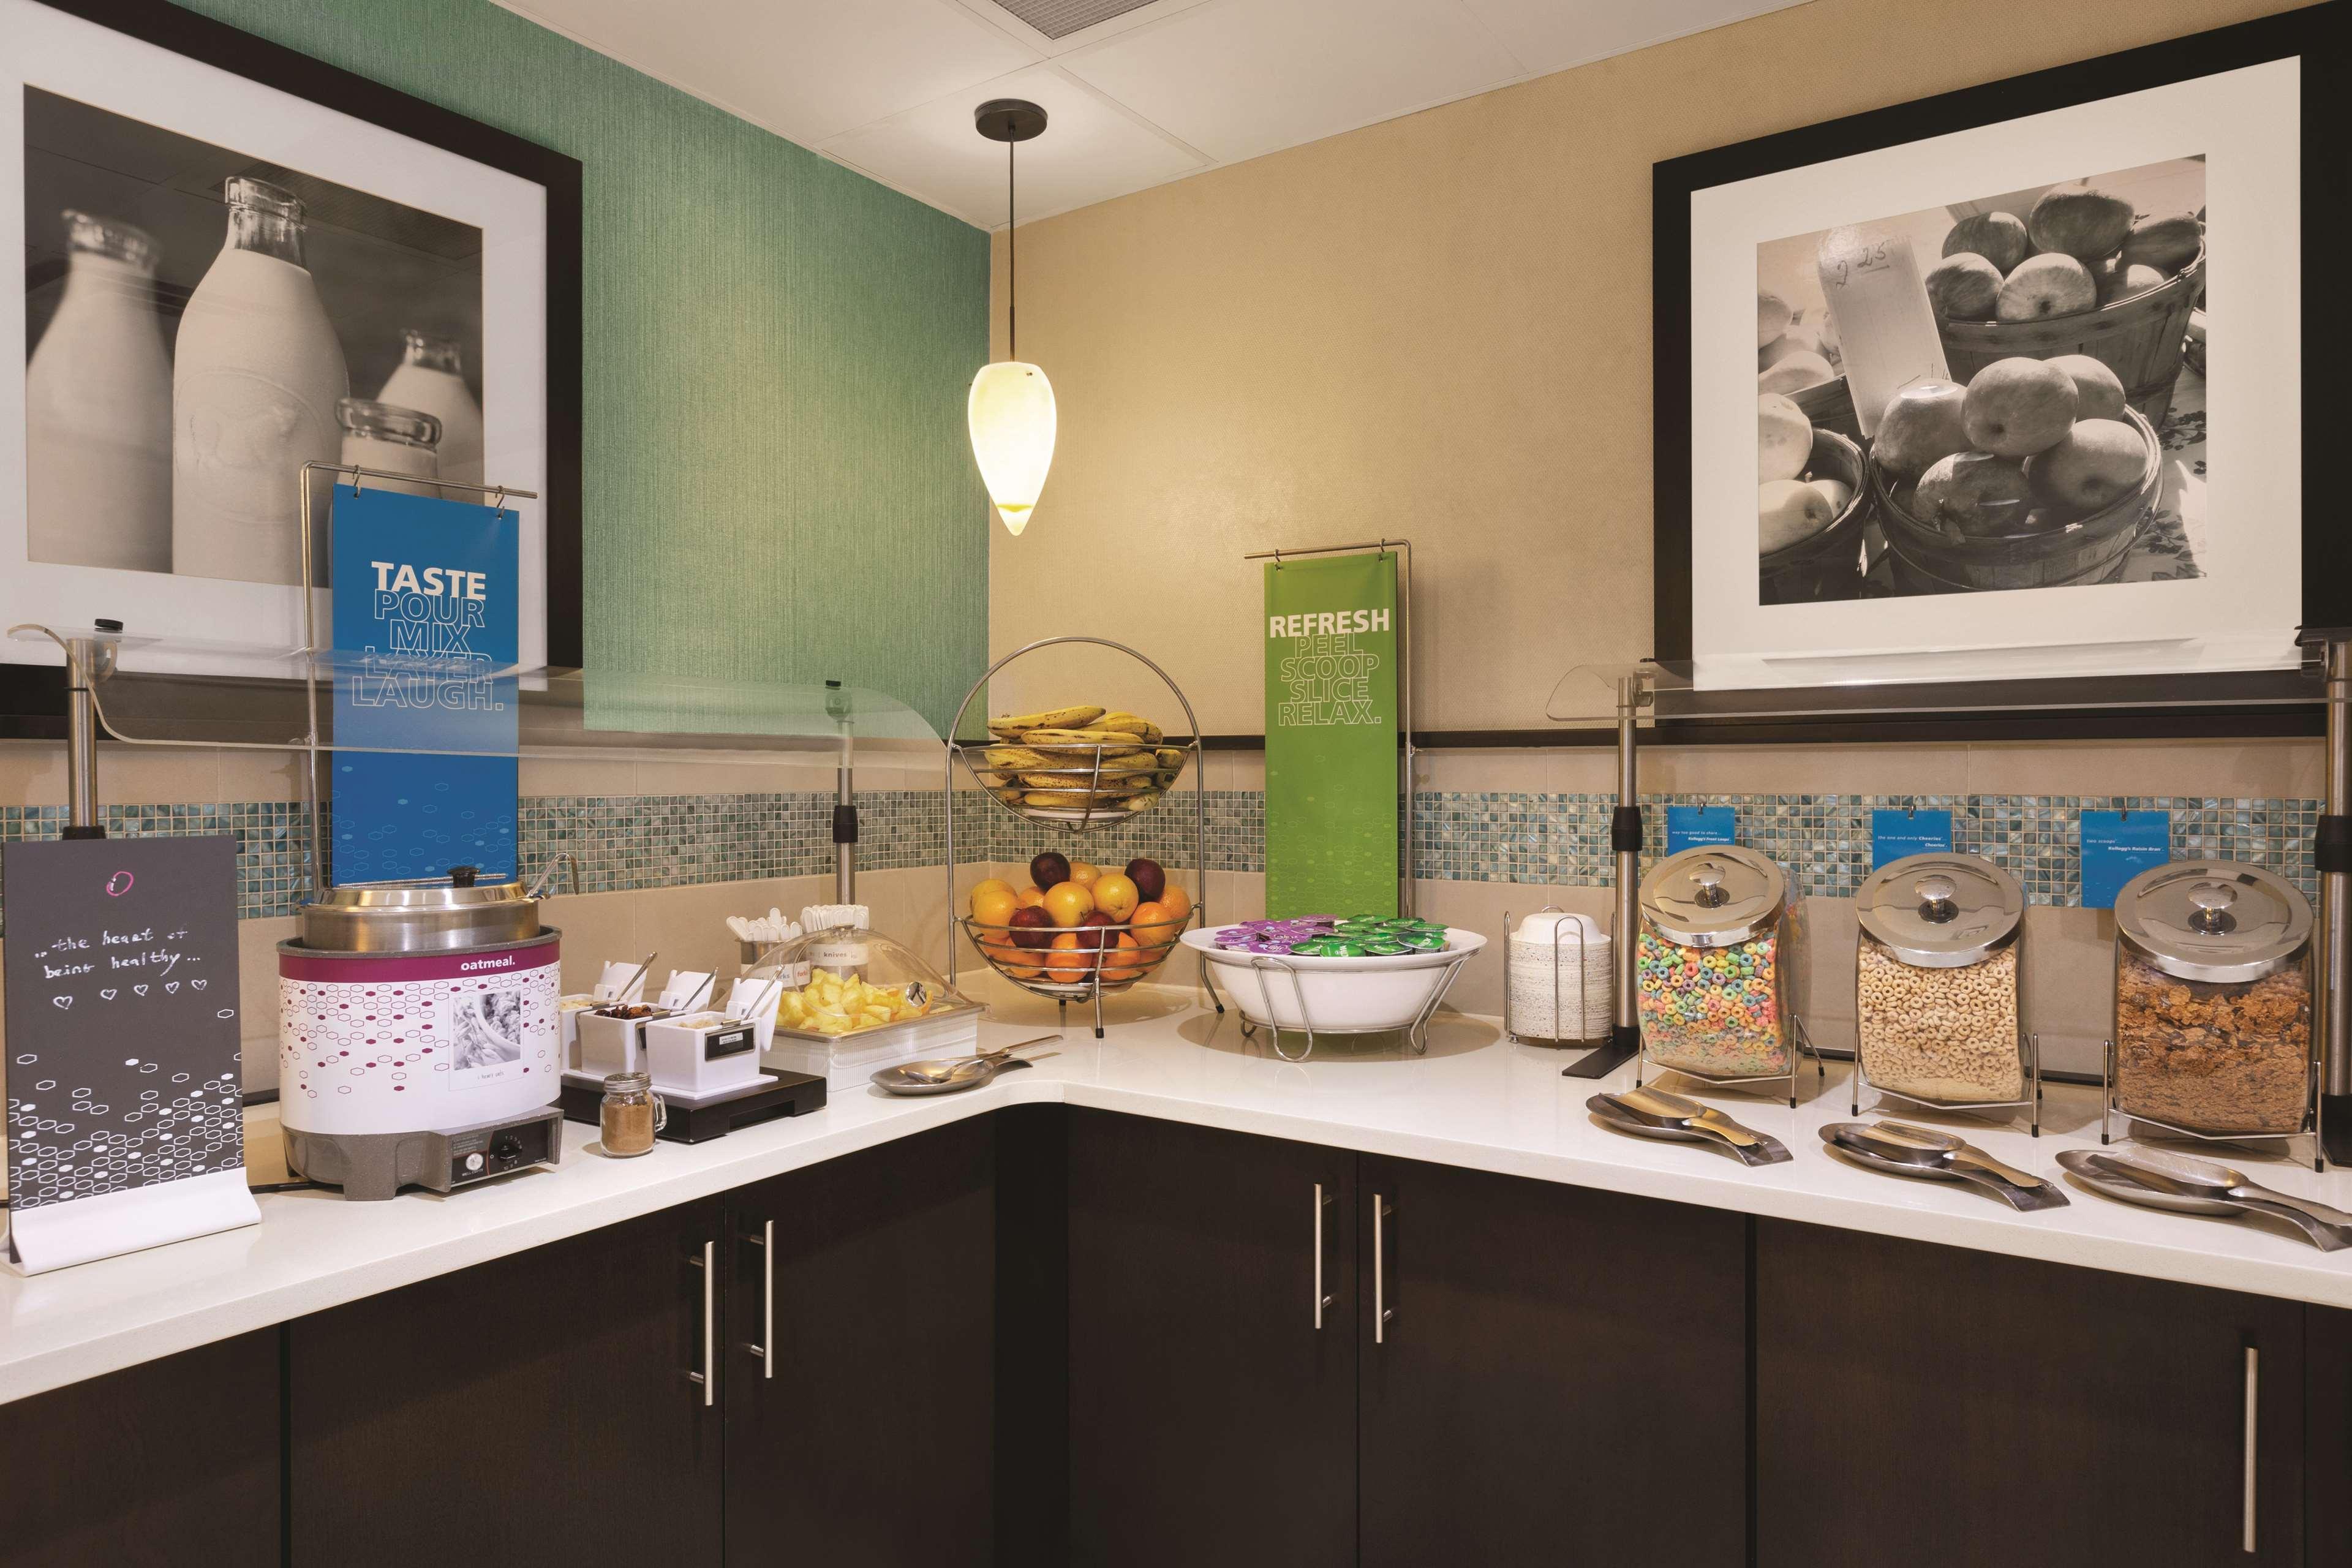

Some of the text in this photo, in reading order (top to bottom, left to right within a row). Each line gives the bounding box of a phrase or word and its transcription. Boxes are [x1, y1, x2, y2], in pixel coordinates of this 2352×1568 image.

[371, 561, 486, 600] TASTE
[375, 589, 485, 627] POUR
[390, 619, 471, 653] MIX
[1270, 608, 1389, 638] REFRESH
[1295, 631, 1363, 658] PEEL
[1281, 654, 1379, 682] SCOOP
[352, 676, 503, 710] LAUGH.
[1290, 677, 1370, 704] SLICE
[1278, 700, 1382, 726] RELAX.
[102, 928, 154, 945] heart
[461, 956, 515, 971] oatmeal.
